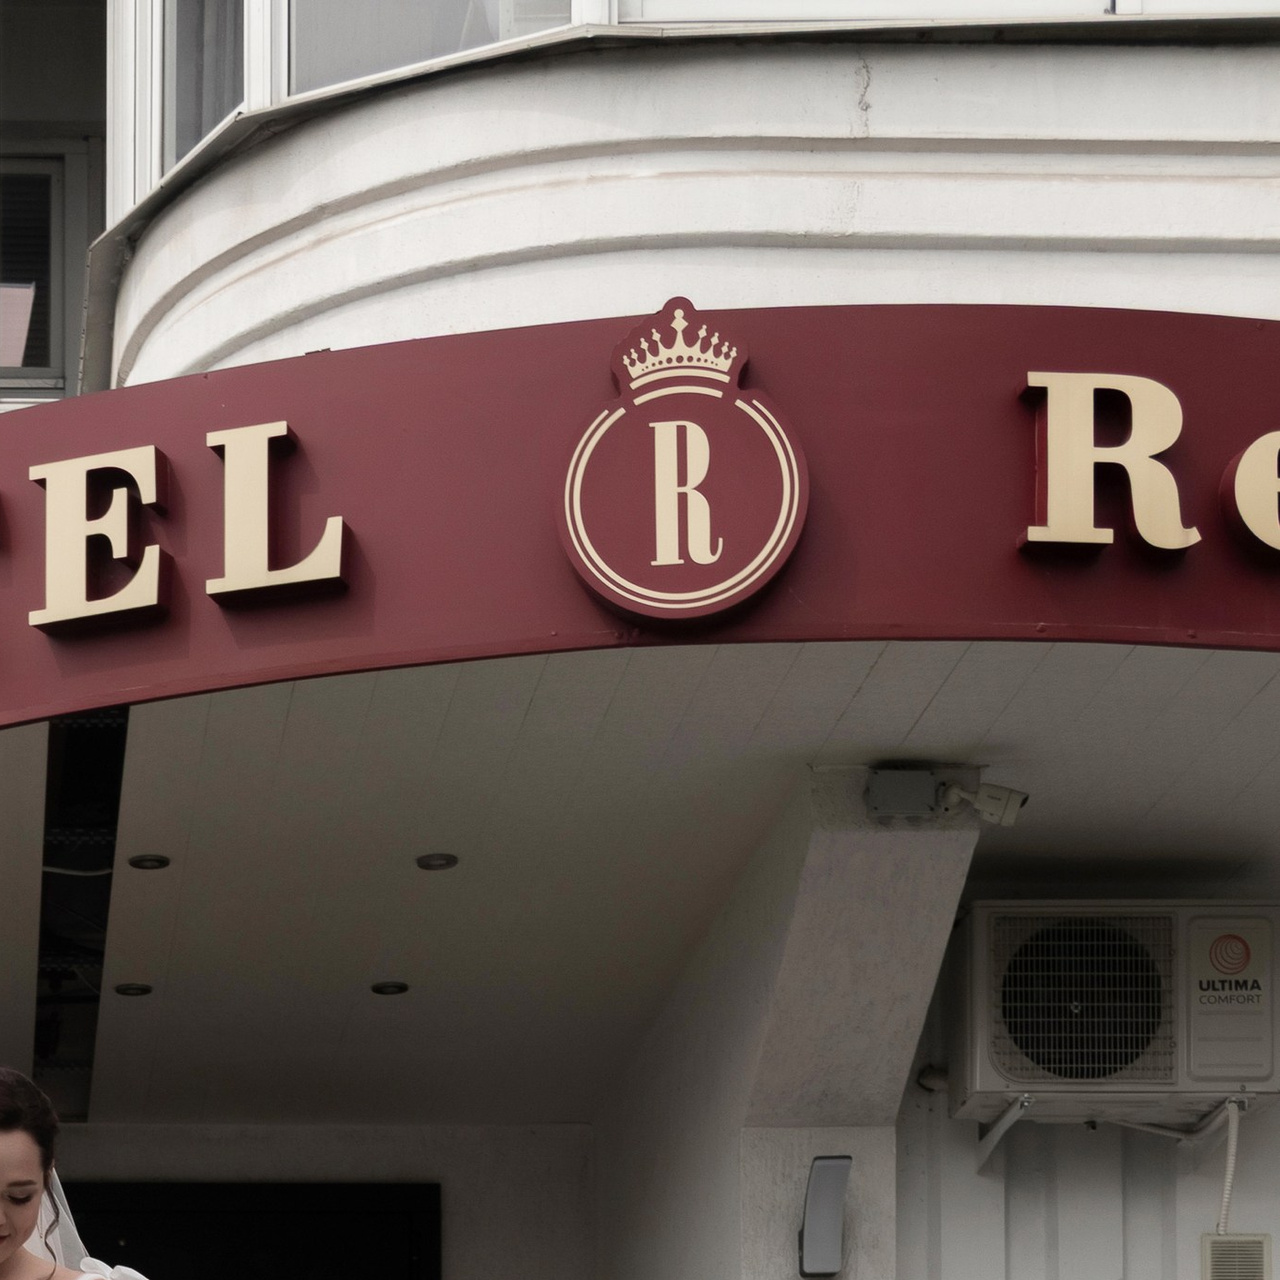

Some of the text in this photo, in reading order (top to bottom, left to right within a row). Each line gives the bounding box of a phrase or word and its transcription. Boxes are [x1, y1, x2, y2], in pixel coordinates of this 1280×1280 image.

[648, 419, 724, 567] R
[1198, 979, 1262, 992] ULTIMA
[1198, 993, 1262, 1005] COMFORT
